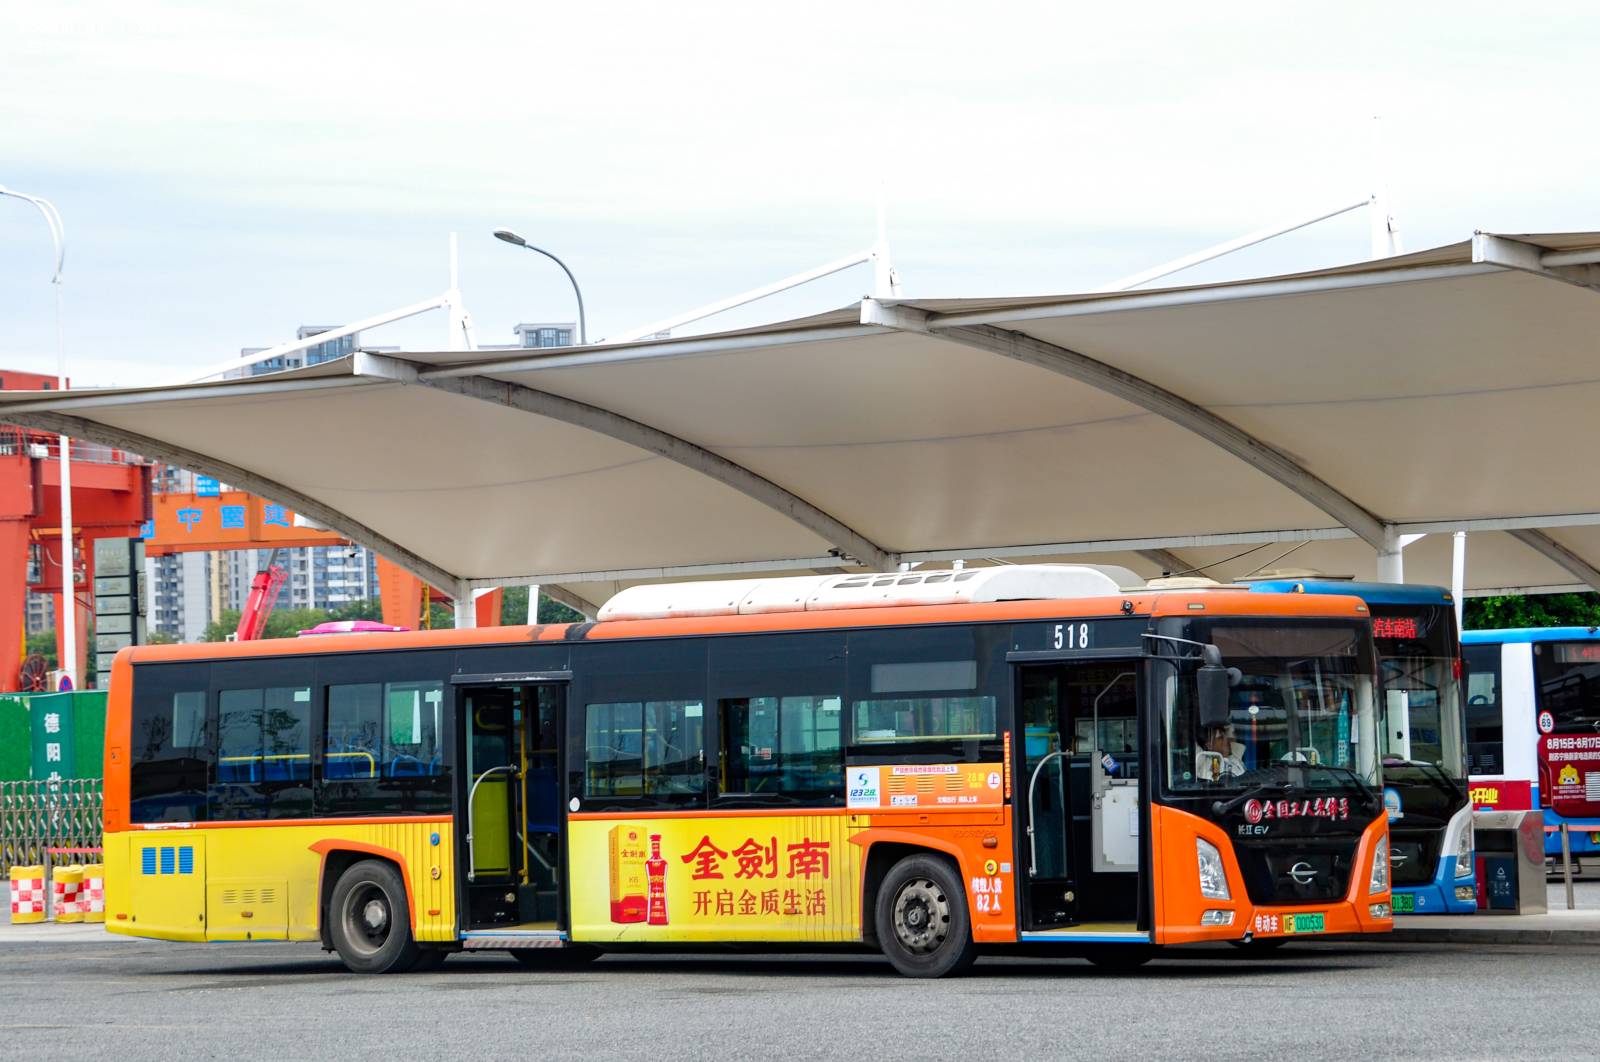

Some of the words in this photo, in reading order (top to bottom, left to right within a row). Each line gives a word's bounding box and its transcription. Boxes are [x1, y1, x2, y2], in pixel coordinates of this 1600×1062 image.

[1054, 624, 1089, 649] 518
[692, 889, 826, 917] 开启金质生活
[1254, 914, 1279, 932] 电动车
